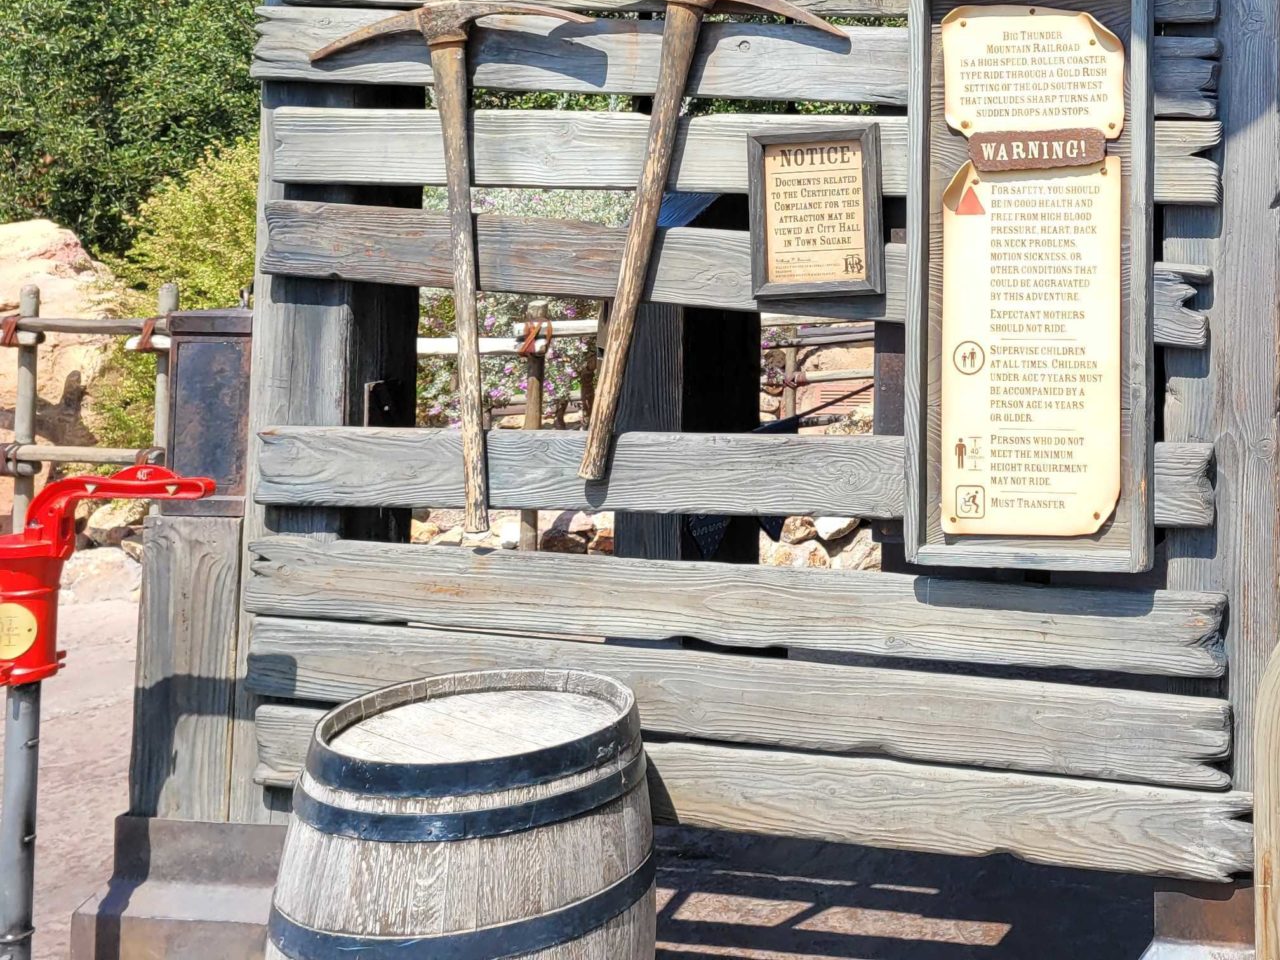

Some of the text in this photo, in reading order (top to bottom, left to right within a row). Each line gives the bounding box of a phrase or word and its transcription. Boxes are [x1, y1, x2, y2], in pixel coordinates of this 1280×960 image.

[1003, 31, 1063, 40] BIG THUNDER
[987, 44, 1080, 54] MOUNTAIN RAILROAD
[978, 58, 999, 66] HIGH
[1031, 57, 1066, 65] ROLLER
[1067, 56, 1107, 64] COASTER
[961, 68, 1107, 80] TYPE RIDE THROUGH GOLD RUSH
[964, 81, 1103, 92] SETTING THE OLD SOUTHWEST
[961, 94, 1108, 105] THAT INCLUDES SHARP TURNS AND
[976, 109, 1009, 117] SUDDEN
[1012, 108, 1040, 116] DROPS
[1042, 108, 1060, 116] AND
[981, 140, 1086, 160] WARNING!
[780, 146, 850, 167] NOTICE
[775, 176, 857, 187] DOCUMENTS RELATED
[771, 192, 780, 200] TO
[783, 191, 798, 199] THE
[801, 188, 850, 198] CERTIFICATE
[992, 185, 1010, 194] FOR
[1047, 186, 1064, 194] YOU
[1065, 186, 1100, 194] SHOULD
[774, 202, 822, 211] COMPLIANCE
[991, 200, 1002, 208] BE
[1003, 200, 1012, 208] IN
[1014, 200, 1037, 208] GOOD
[1075, 199, 1093, 207] AND
[779, 214, 825, 223] ATTRACTION
[991, 213, 1013, 221] FREE
[1015, 213, 1039, 221] FROM
[817, 224, 836, 233] CITY
[839, 223, 861, 232] HALL
[1073, 226, 1097, 234] BACK
[795, 237, 817, 246] TOWN
[820, 237, 851, 245] SQUARE
[1004, 239, 1027, 247] NECK
[990, 266, 1097, 274] OTHER CONDITIONS THAT
[990, 279, 1090, 287] COULD AGGRAVATED
[990, 309, 1085, 319] EXPECTANT MOTHERS
[990, 324, 1024, 332] SHOULD
[1026, 324, 1043, 332] NOT
[990, 345, 1086, 355] SUPERVISE CHILDREN
[990, 360, 1003, 368] AT
[1004, 360, 1020, 368] ALL
[1052, 359, 1097, 369] CHILDREN
[990, 374, 1103, 383] UNDER AGE 7 YEARS MUST
[990, 387, 1078, 396] BE ACCOMPANIED BY
[990, 401, 1084, 409] PERSON AGE 14 YEARS
[990, 414, 1002, 422] OR
[991, 435, 1084, 445] PERSONS WHO DO NOT
[991, 450, 1014, 459] MEET
[1015, 450, 1032, 459] THE
[1033, 450, 1073, 459] MINIMUM
[991, 464, 1087, 473] HEIGHT REQUIREMENT
[991, 477, 1008, 485] MAY
[1010, 477, 1027, 485] NOT
[991, 498, 1065, 509] MUST TRANSFER
